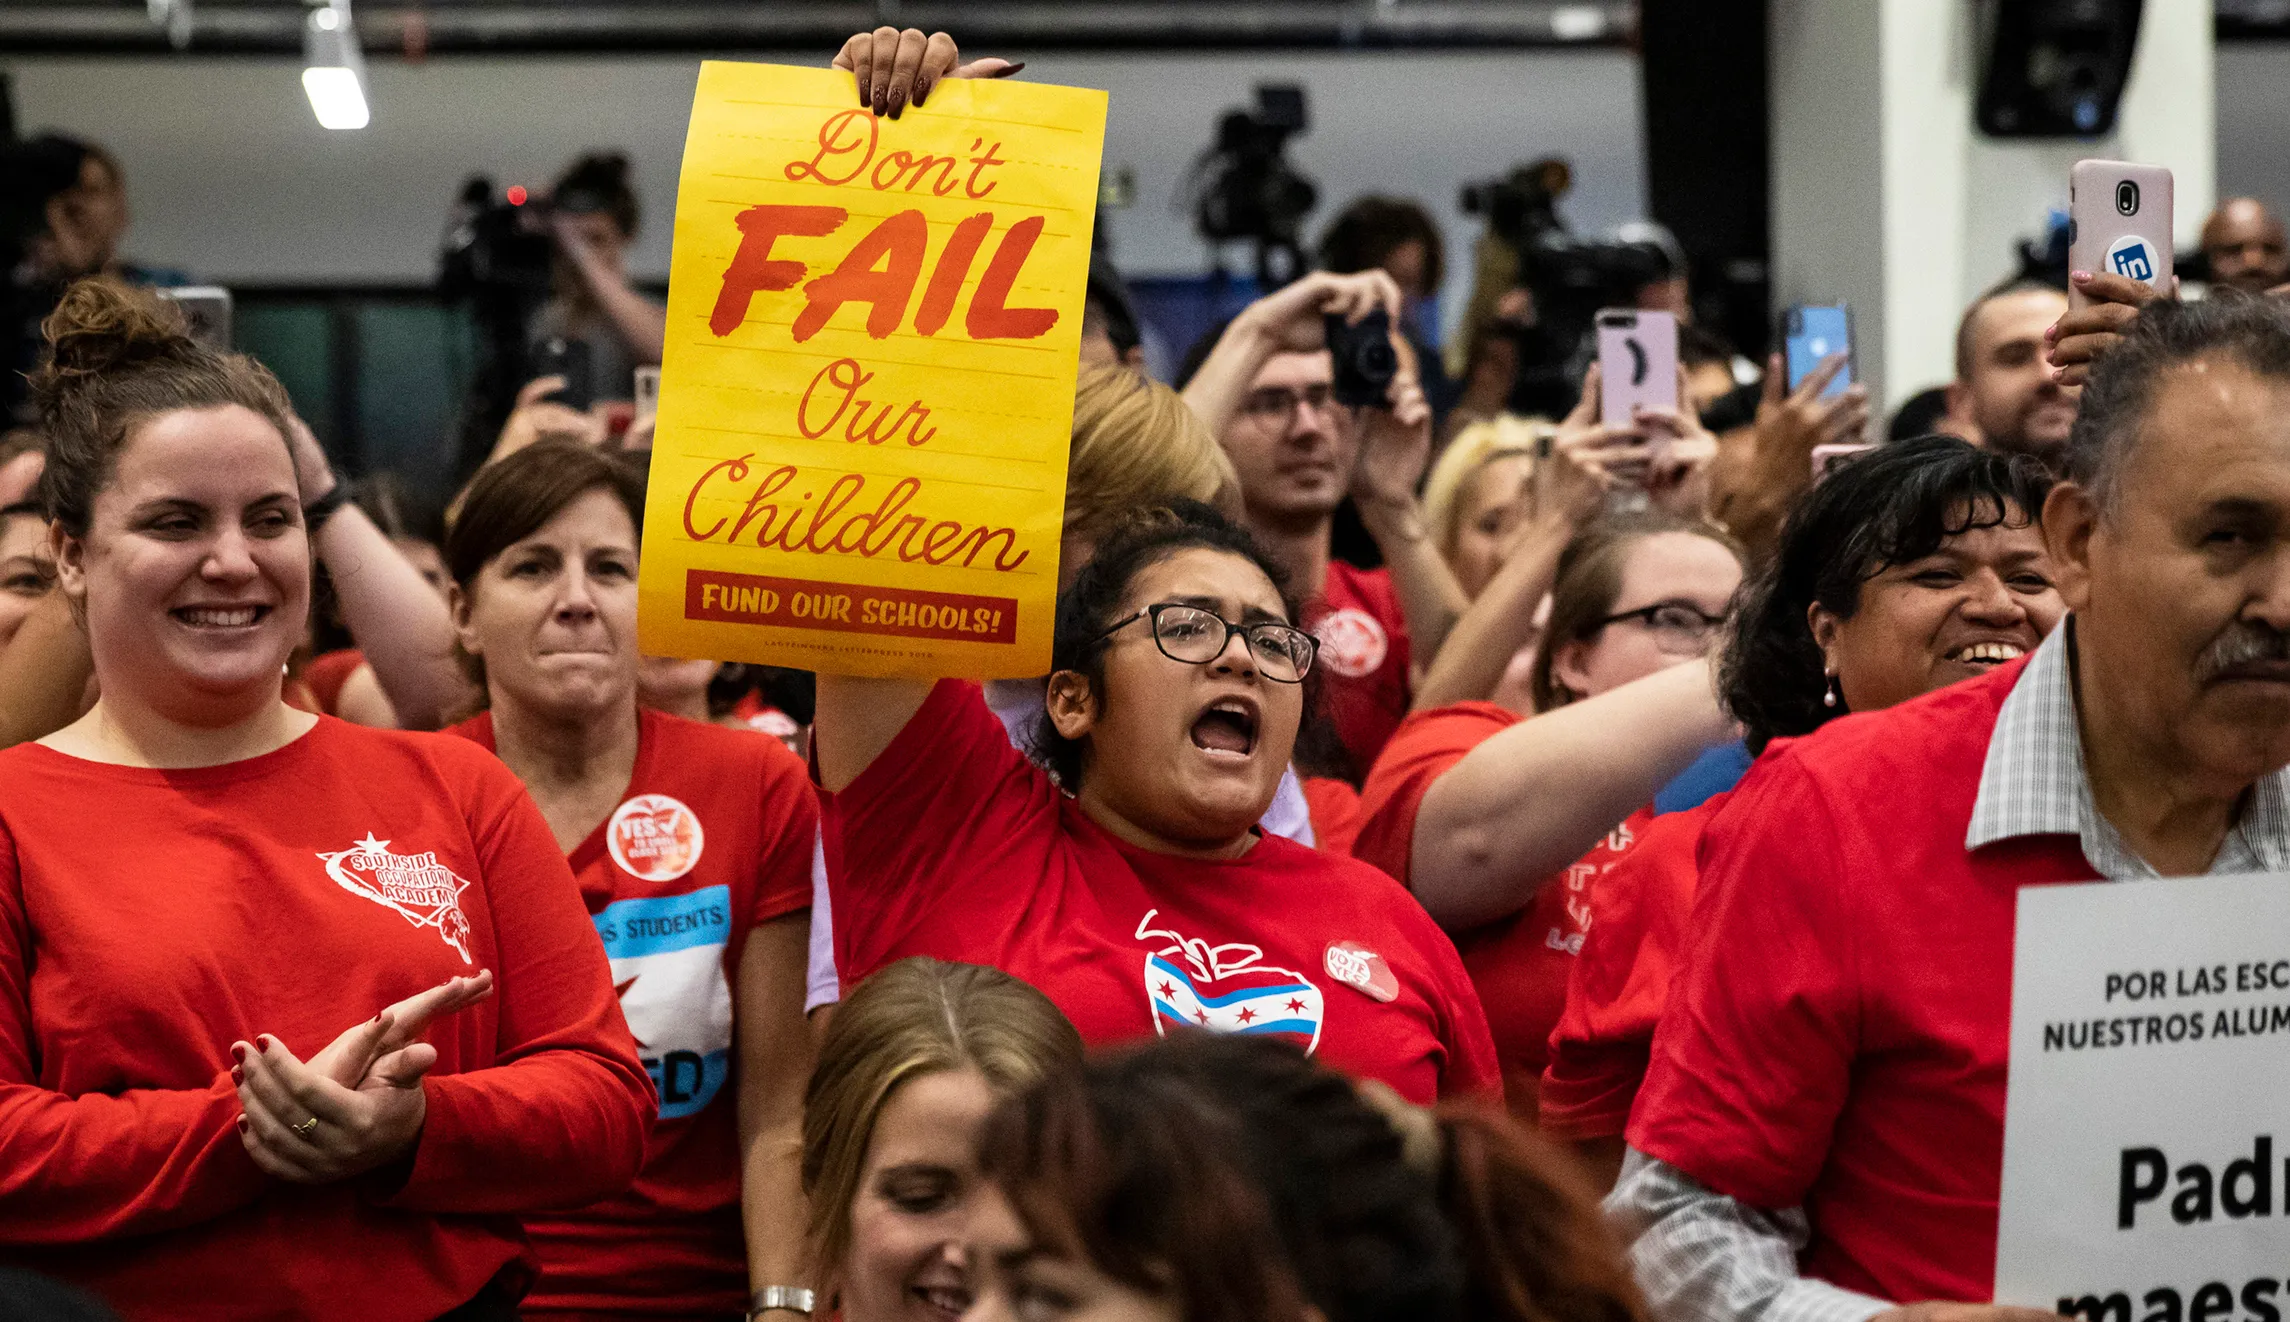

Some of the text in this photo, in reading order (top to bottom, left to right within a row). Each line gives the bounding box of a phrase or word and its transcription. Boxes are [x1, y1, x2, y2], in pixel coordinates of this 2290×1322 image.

[784, 109, 1004, 198] Don't
[709, 204, 1059, 343] FAIL
[798, 358, 936, 447] Our
[682, 453, 1029, 572] Children
[701, 583, 1002, 634] FUND OUR SCHOOLS!
[620, 816, 657, 839] YES
[351, 852, 435, 870] SOUTHSIDE
[383, 886, 457, 906] ACADEMY
[627, 905, 723, 940] STUDENTS
[1330, 950, 1366, 973] VOTE
[2105, 960, 2290, 1002] POR LAS ESC
[2043, 1011, 2205, 1051] NUESTROS
